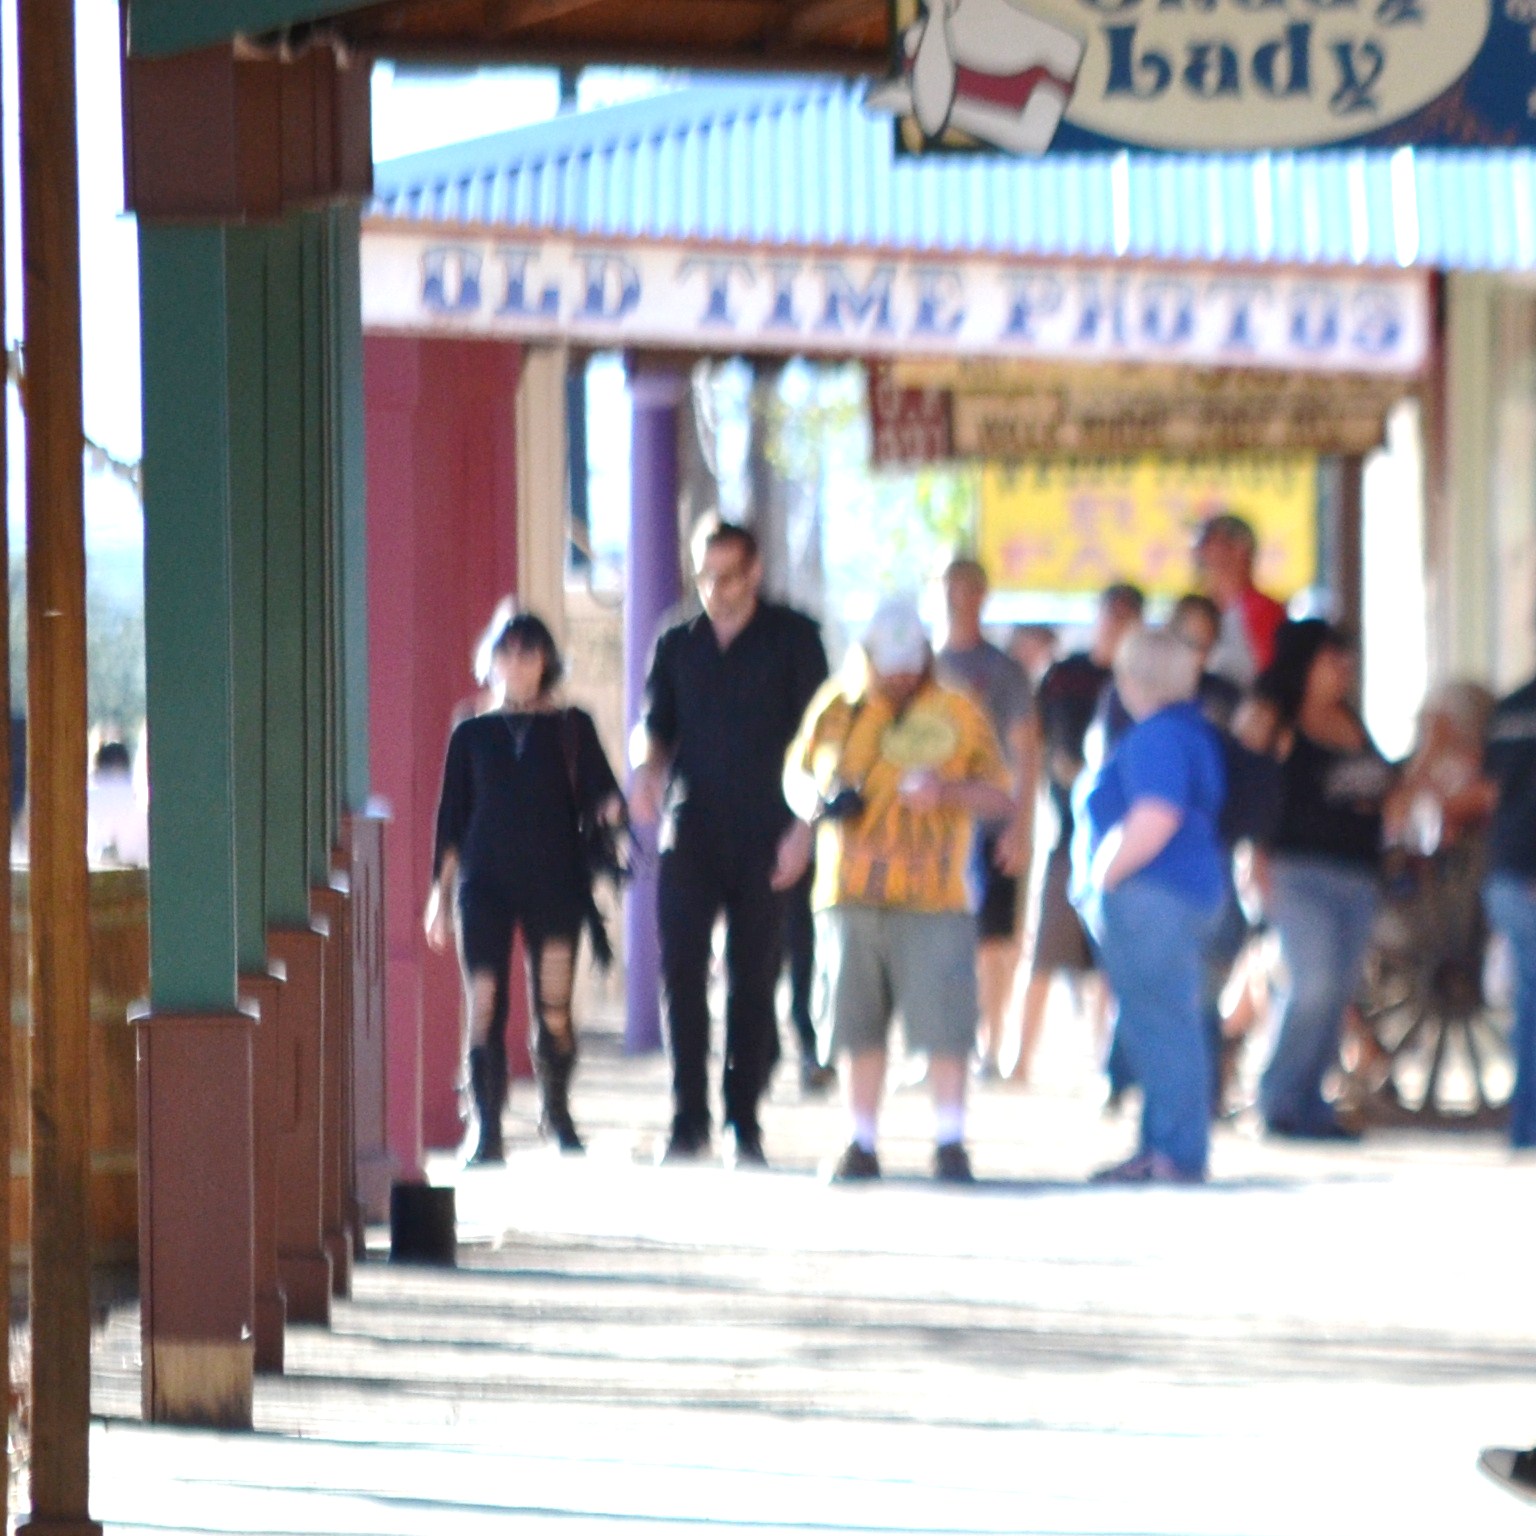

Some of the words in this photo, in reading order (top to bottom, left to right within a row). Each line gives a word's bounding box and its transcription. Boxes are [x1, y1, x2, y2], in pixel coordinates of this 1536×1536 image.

[1103, 22, 1385, 117] Lady
[418, 246, 642, 318] OLD
[676, 255, 967, 335] TIME
[998, 268, 1403, 352] PHOTOS
